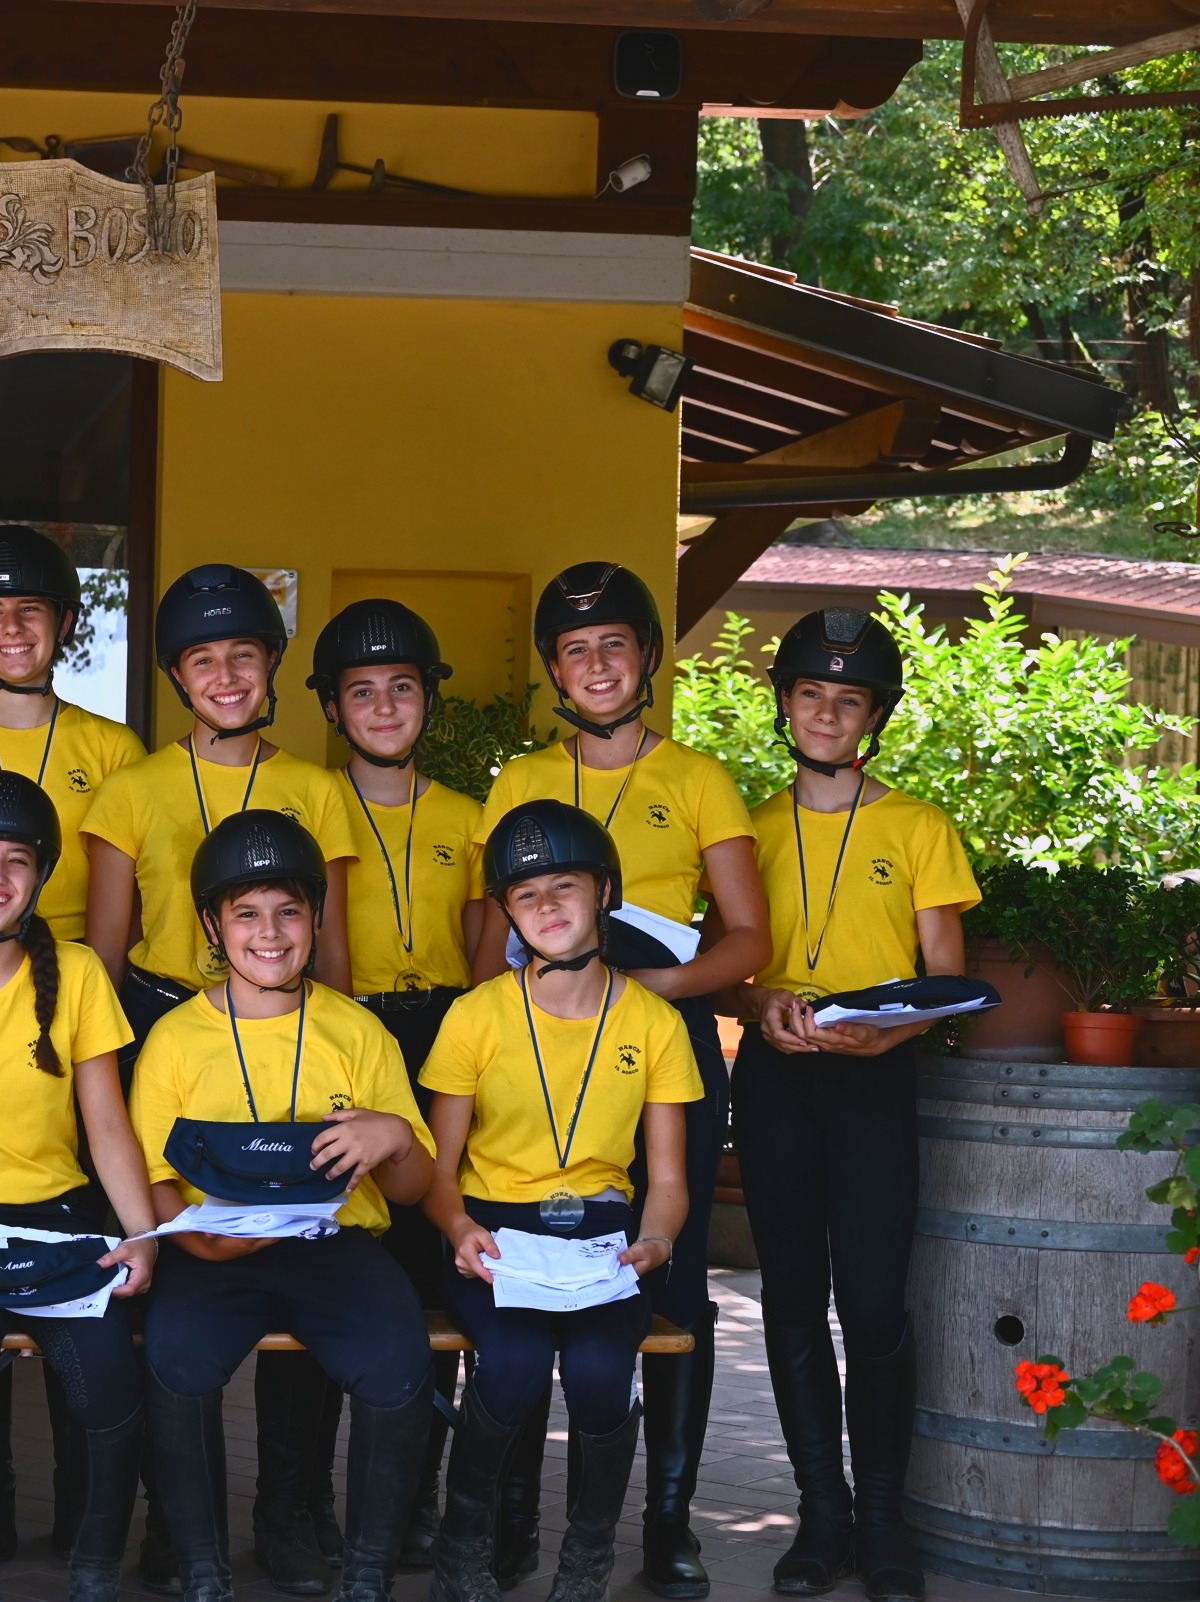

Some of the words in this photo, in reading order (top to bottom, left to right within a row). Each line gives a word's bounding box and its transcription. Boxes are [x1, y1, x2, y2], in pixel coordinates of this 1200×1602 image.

[67, 204, 203, 268] BOSO
[617, 1044, 642, 1055] RANCH
[328, 1093, 352, 1103] RANCH
[241, 1137, 295, 1152] Mattia
[0, 1260, 36, 1271] Anna
